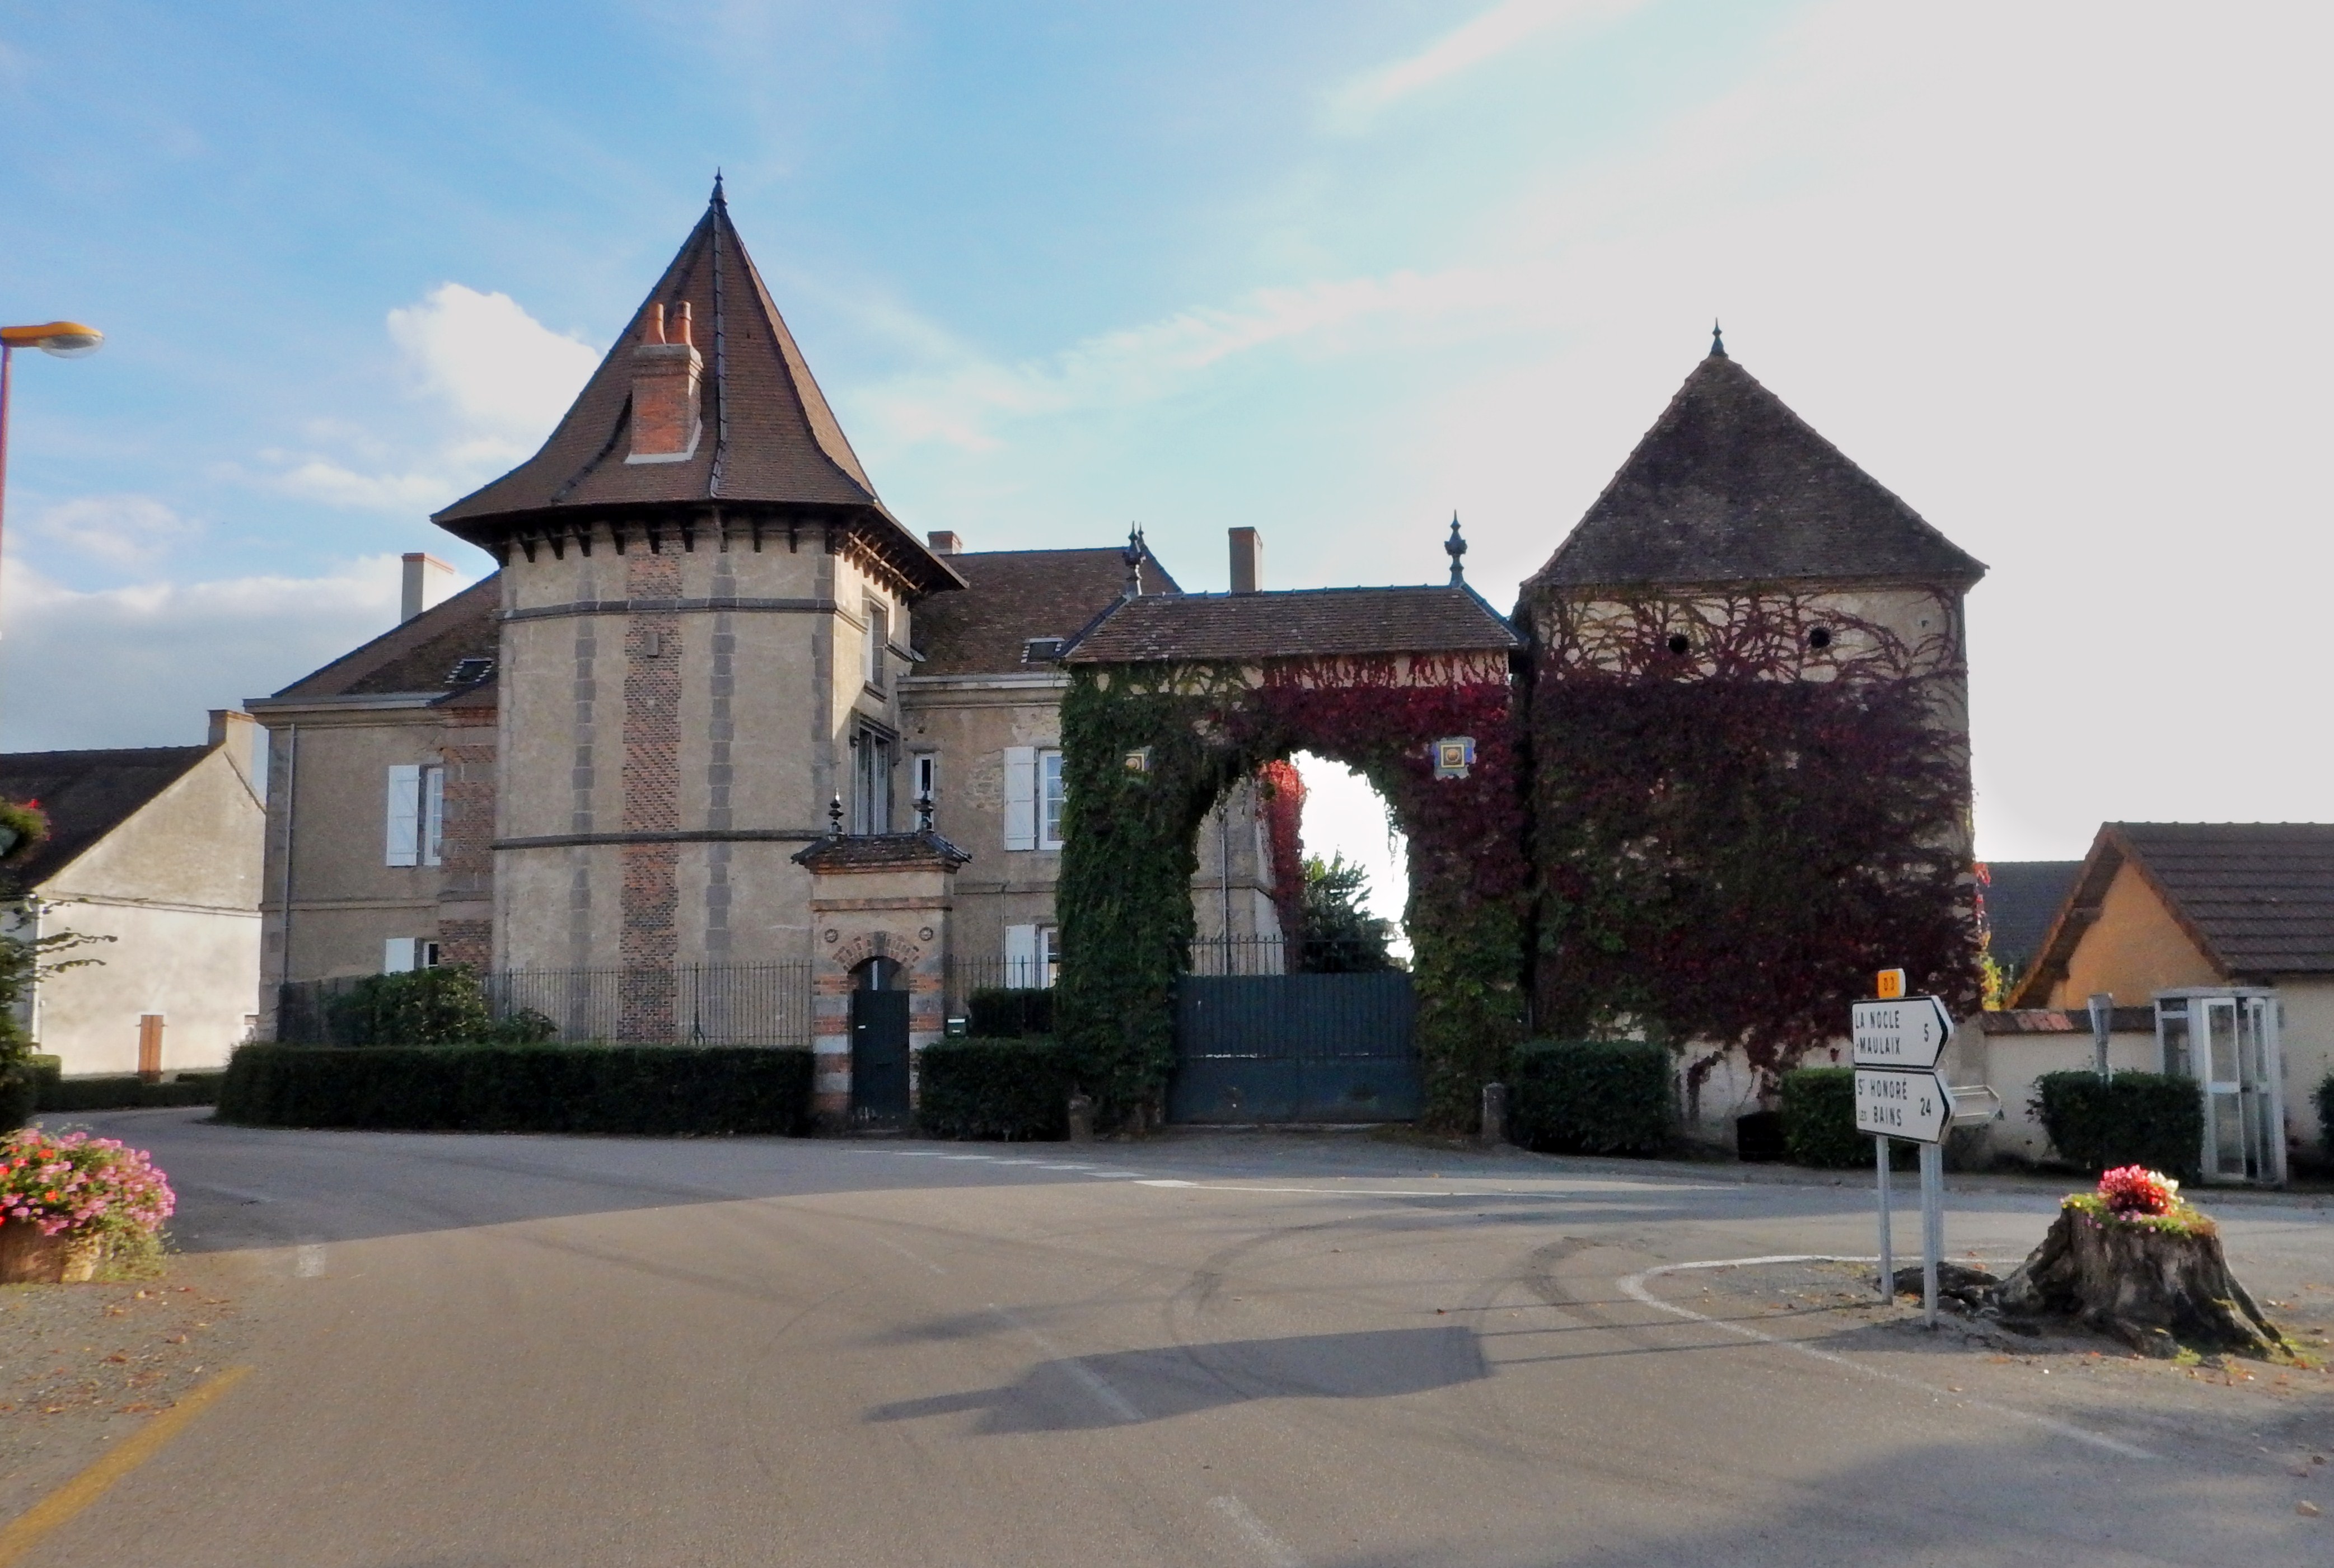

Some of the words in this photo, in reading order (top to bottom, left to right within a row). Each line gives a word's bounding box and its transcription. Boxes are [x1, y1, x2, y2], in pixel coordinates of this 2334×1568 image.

[1855, 1012, 1865, 1029] LA
[1870, 1010, 1900, 1029] NOCLE
[1924, 1023, 1929, 1042] 5
[1873, 1106, 1902, 1127] BAINS
[1920, 1097, 1931, 1117] 24
